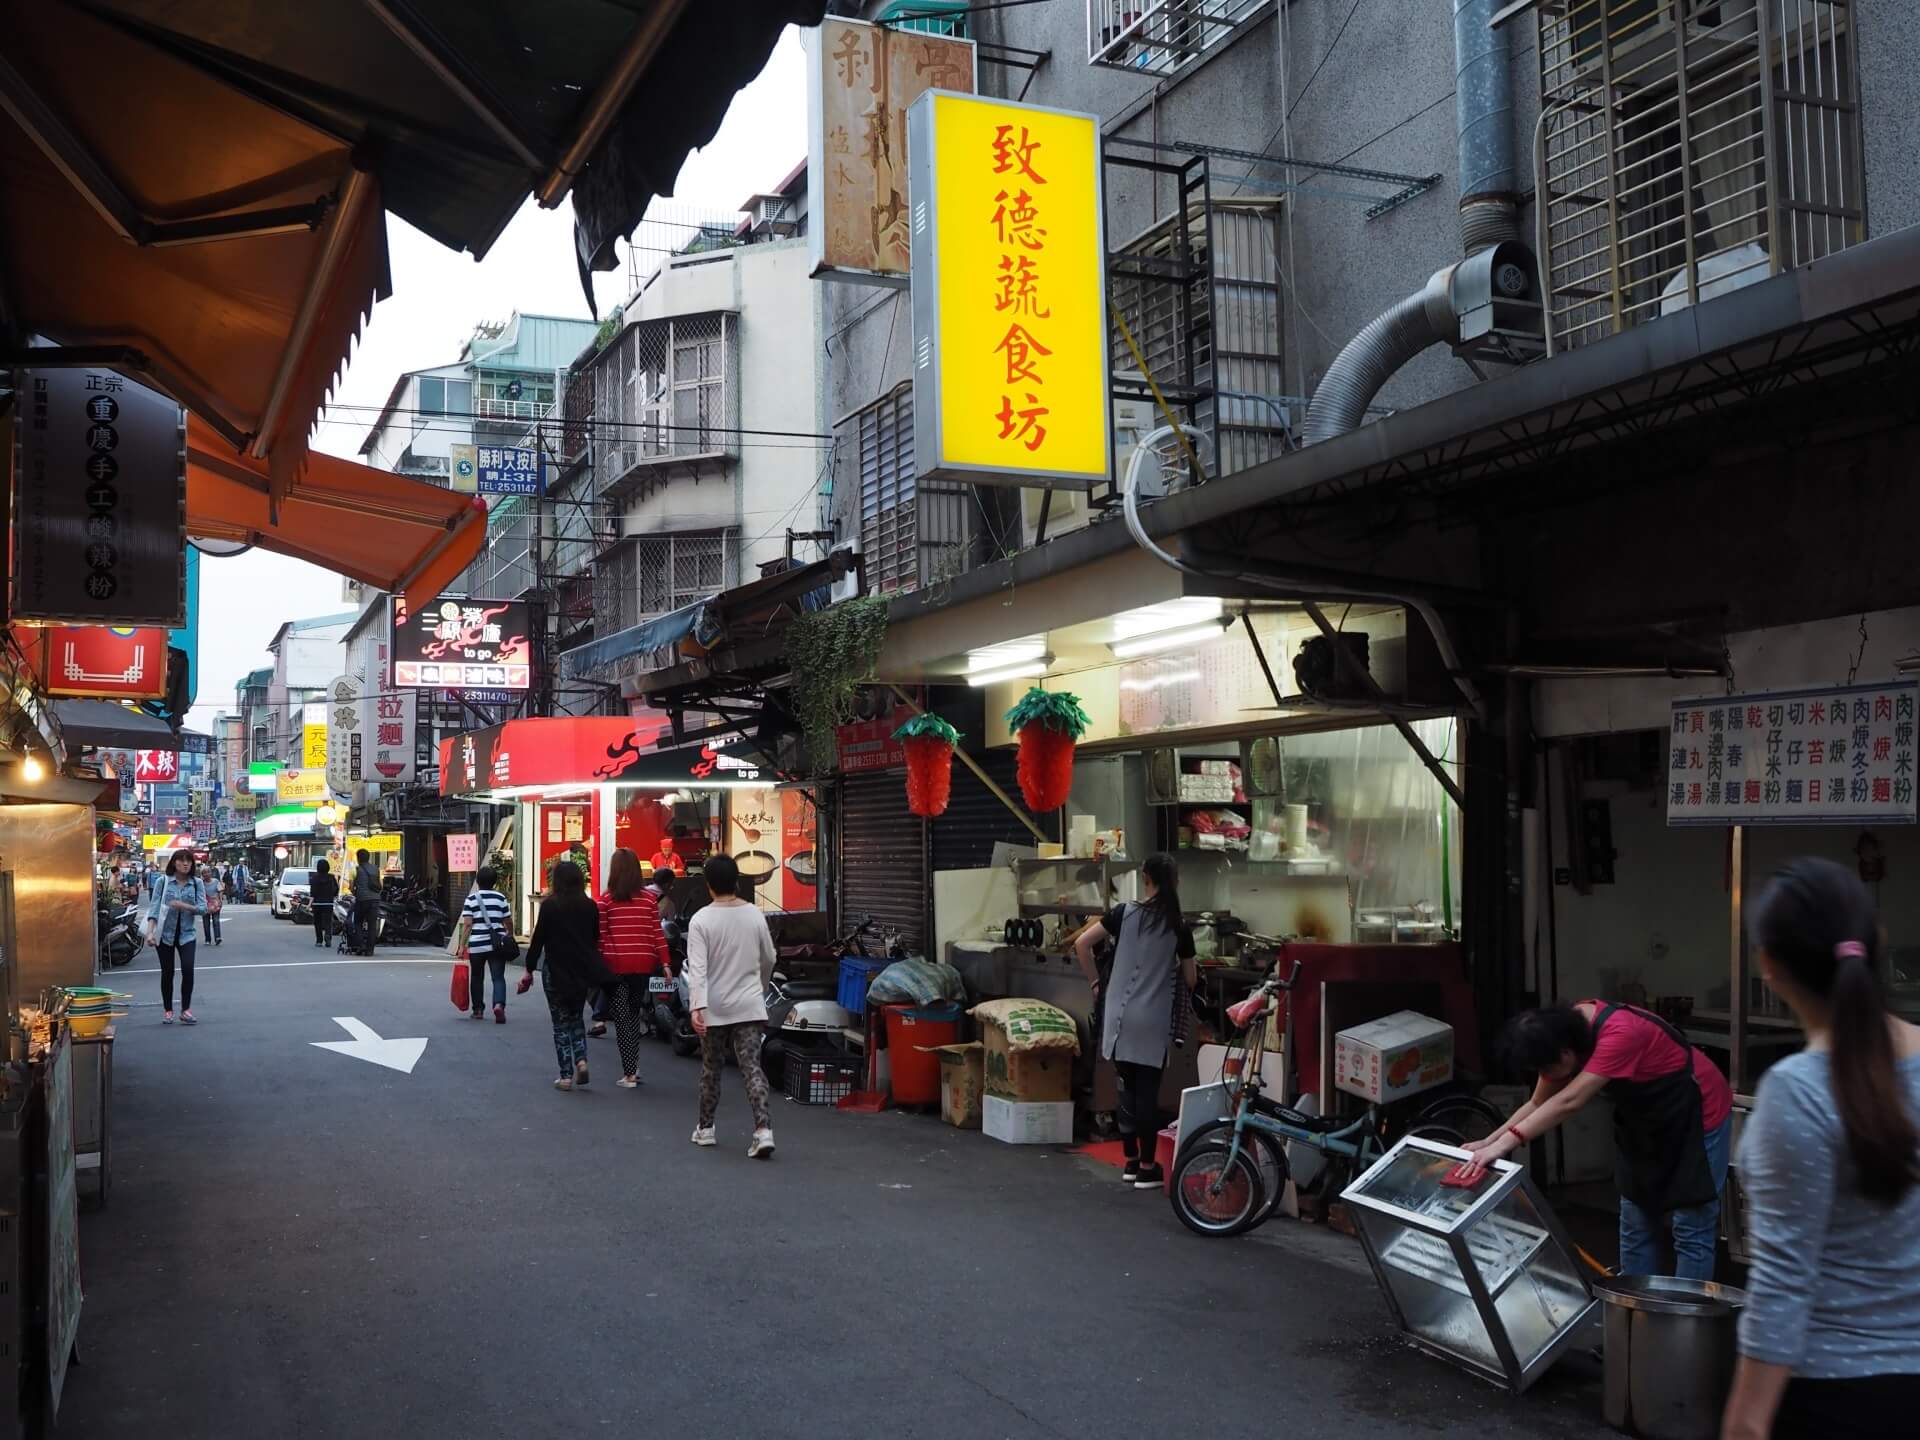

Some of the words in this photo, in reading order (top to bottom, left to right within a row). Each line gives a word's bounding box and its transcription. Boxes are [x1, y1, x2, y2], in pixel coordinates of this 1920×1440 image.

[990, 124, 1053, 452] 致德蔬食坊
[86, 374, 123, 393] 正宗
[464, 647, 476, 658] to
[477, 649, 492, 660] go
[738, 769, 747, 778] to
[748, 770, 759, 779] go
[1670, 712, 1688, 804] 肝漣湯
[1687, 710, 1705, 805] 貢丸湯
[1706, 708, 1725, 804] 嘴邊肉湯
[1725, 706, 1743, 804] 陽春麵
[1744, 704, 1763, 803] 乾麵
[1764, 704, 1783, 804] 切仔米粉
[1786, 702, 1805, 804] 切仔麵
[1808, 701, 1825, 801] 米苔目
